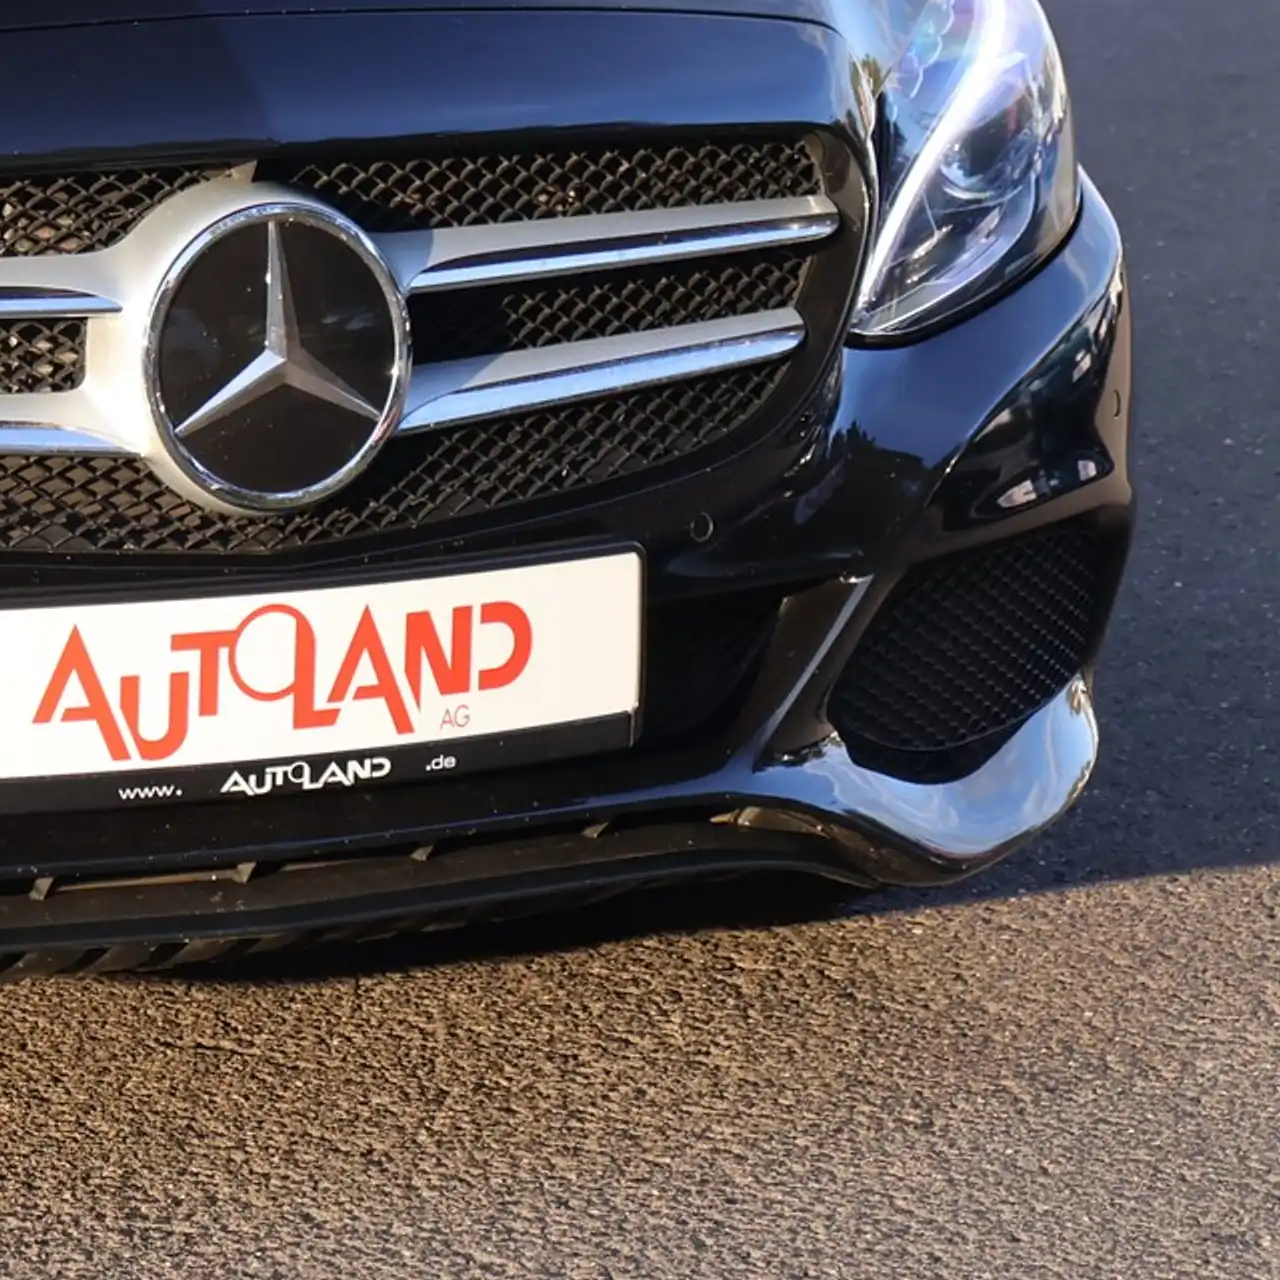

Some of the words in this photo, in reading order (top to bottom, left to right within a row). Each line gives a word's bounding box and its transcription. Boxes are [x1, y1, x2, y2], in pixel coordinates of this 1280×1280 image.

[32, 600, 533, 762] AUTOLAND
[439, 705, 471, 730] AG
[118, 784, 183, 801] www.
[220, 757, 391, 797] AUTOLAND
[425, 755, 456, 772] .de
